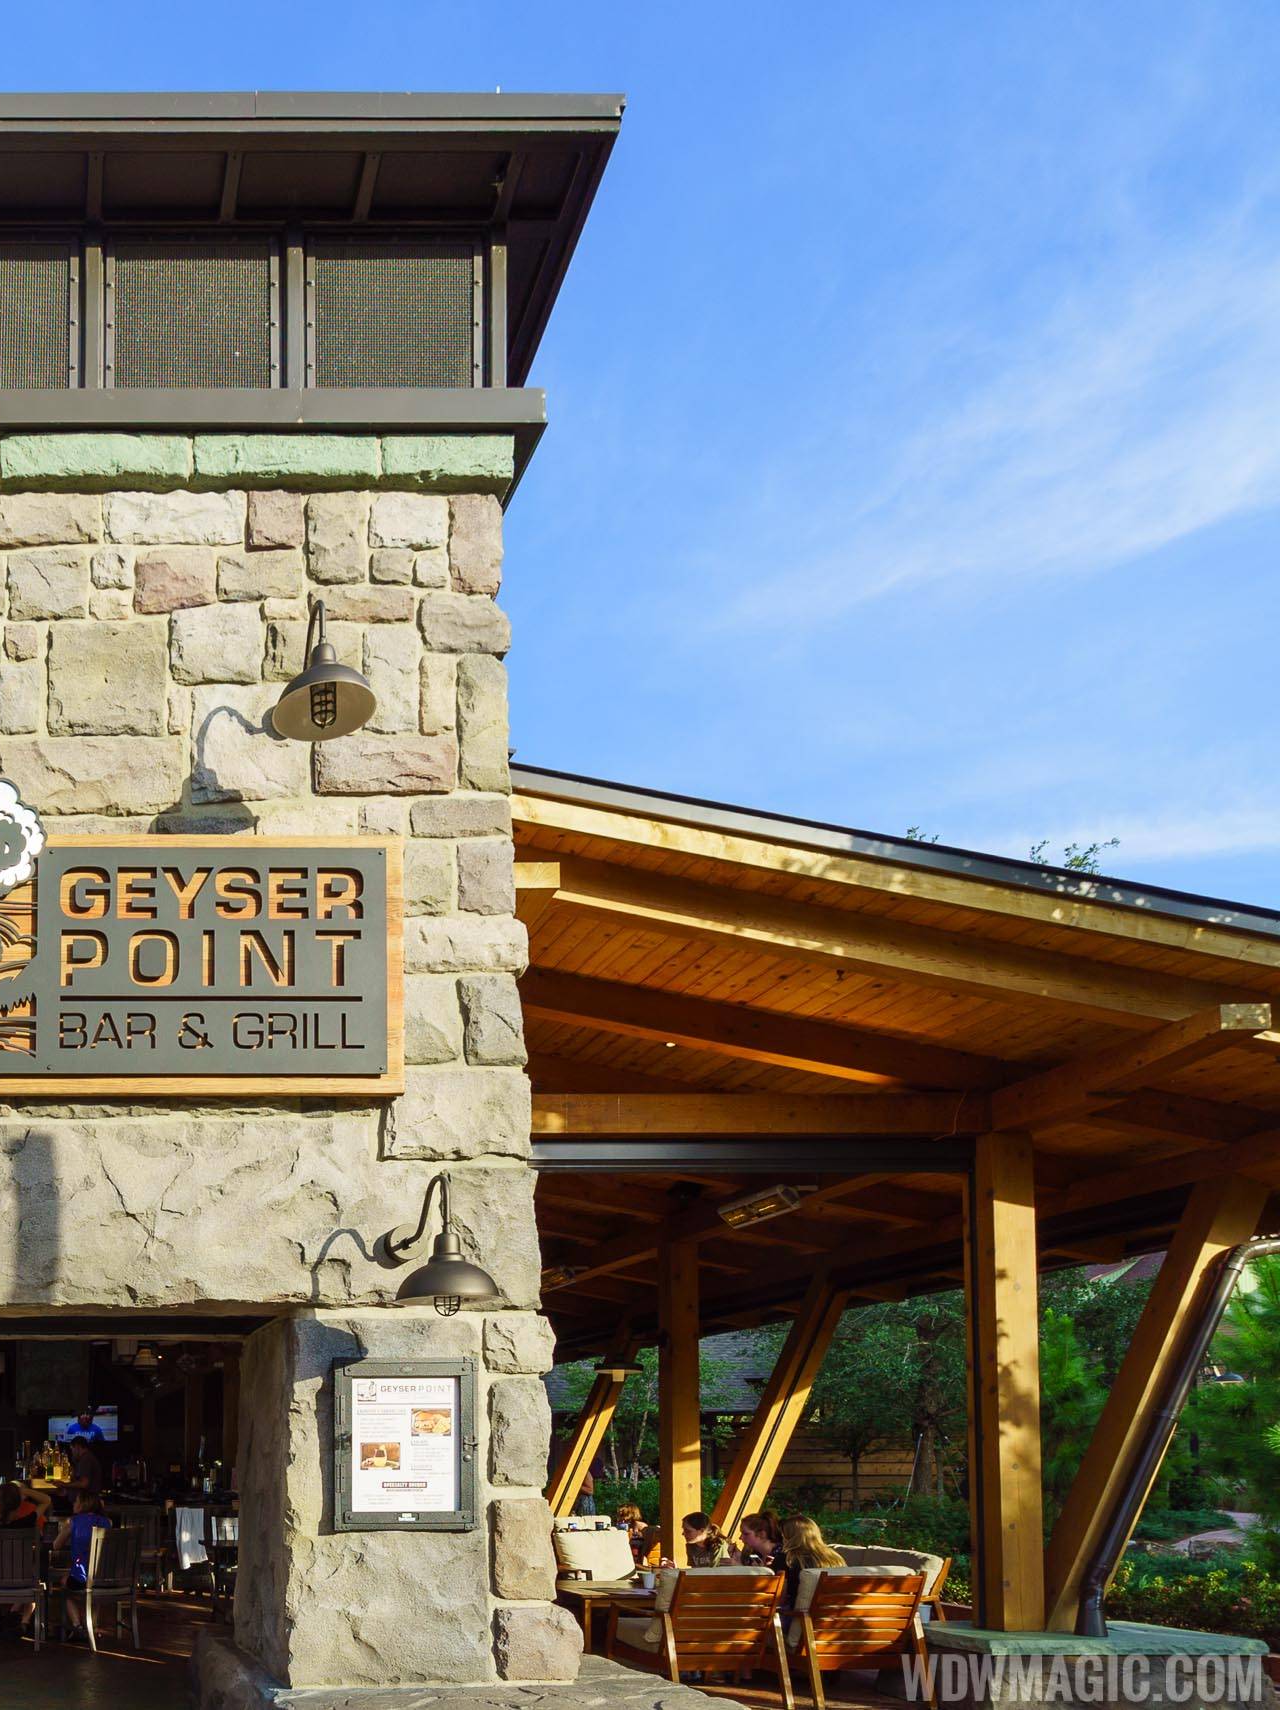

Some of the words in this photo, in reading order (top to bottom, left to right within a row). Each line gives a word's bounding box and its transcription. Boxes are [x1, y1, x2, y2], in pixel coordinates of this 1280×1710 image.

[59, 866, 365, 920] GEYSER
[60, 929, 362, 987] POINT
[58, 1012, 157, 1050] BAR
[177, 1012, 215, 1050] &
[232, 1012, 365, 1050] GRILL
[380, 1385, 417, 1393] GEYSER
[419, 1384, 452, 1393] POINT
